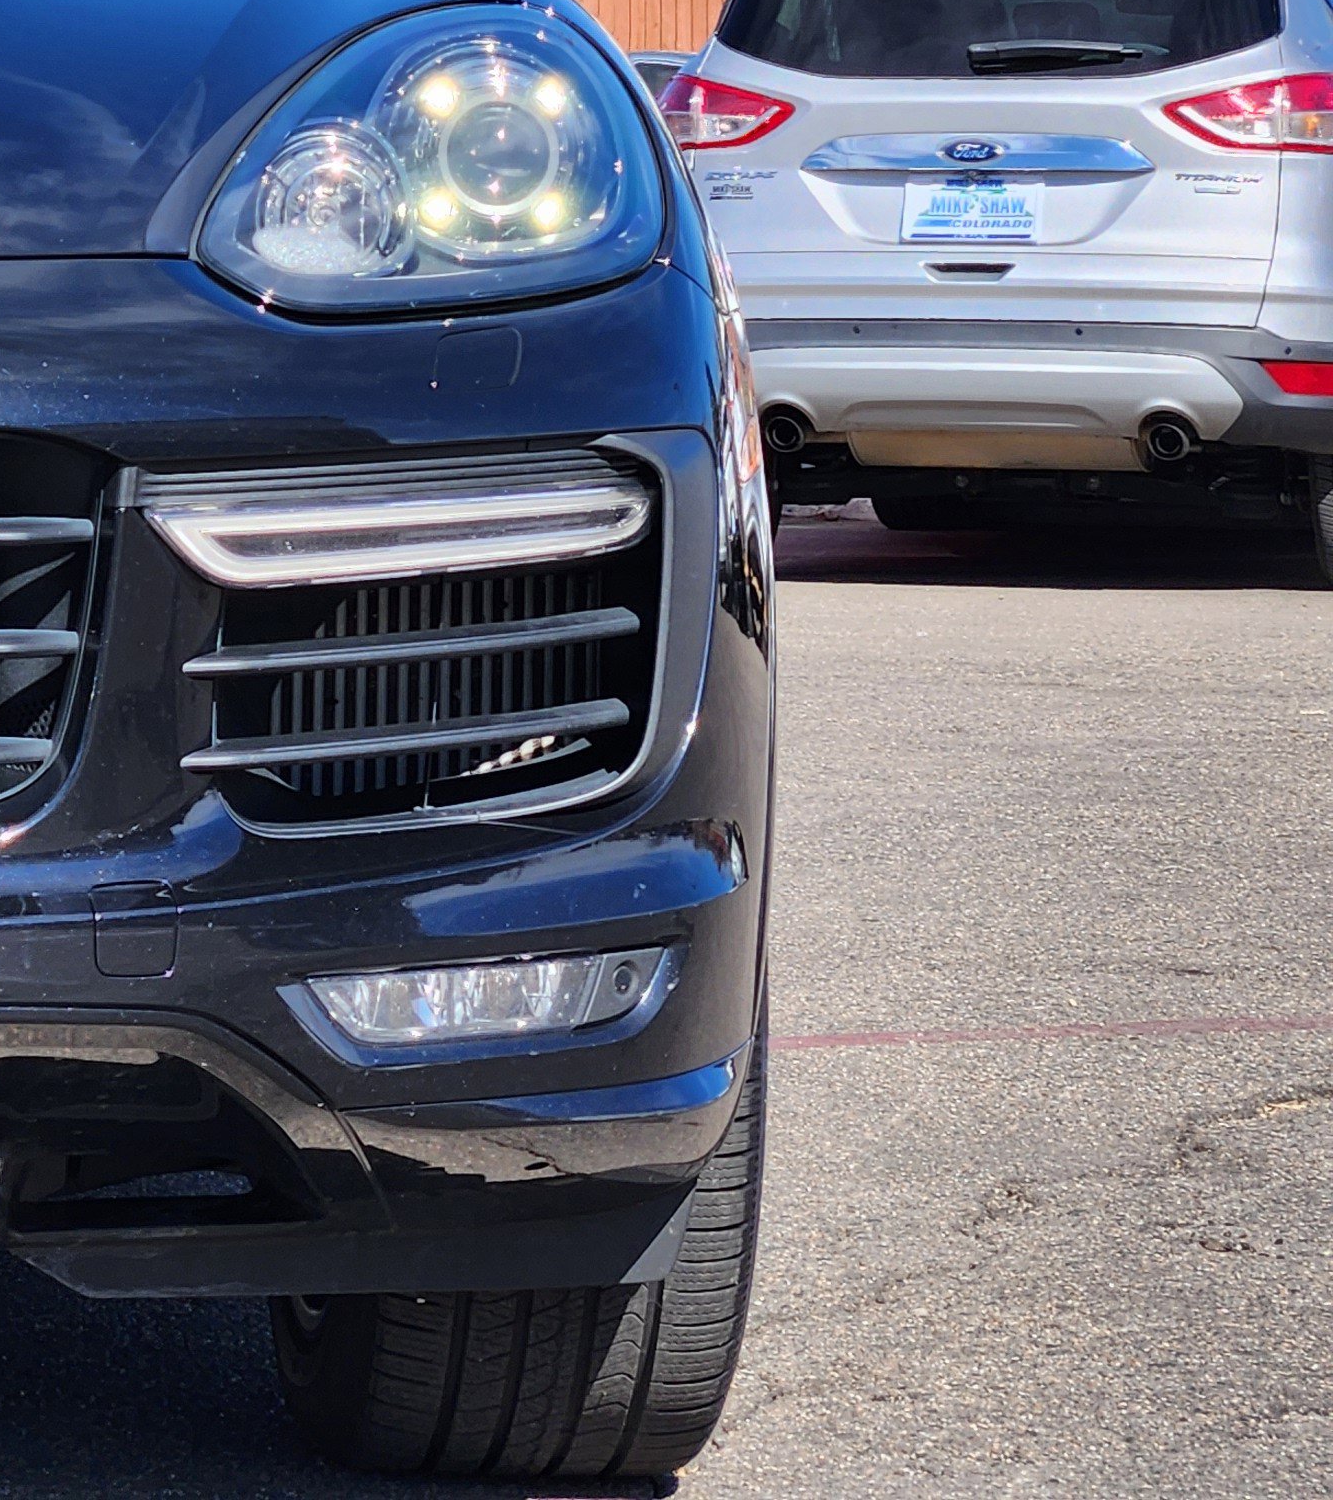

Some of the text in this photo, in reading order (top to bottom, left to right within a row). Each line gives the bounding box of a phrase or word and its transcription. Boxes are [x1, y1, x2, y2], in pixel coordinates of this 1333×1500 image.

[953, 143, 990, 159] Ford
[930, 196, 1026, 214] MIKE SHAW
[951, 219, 1033, 229] COLORADO
